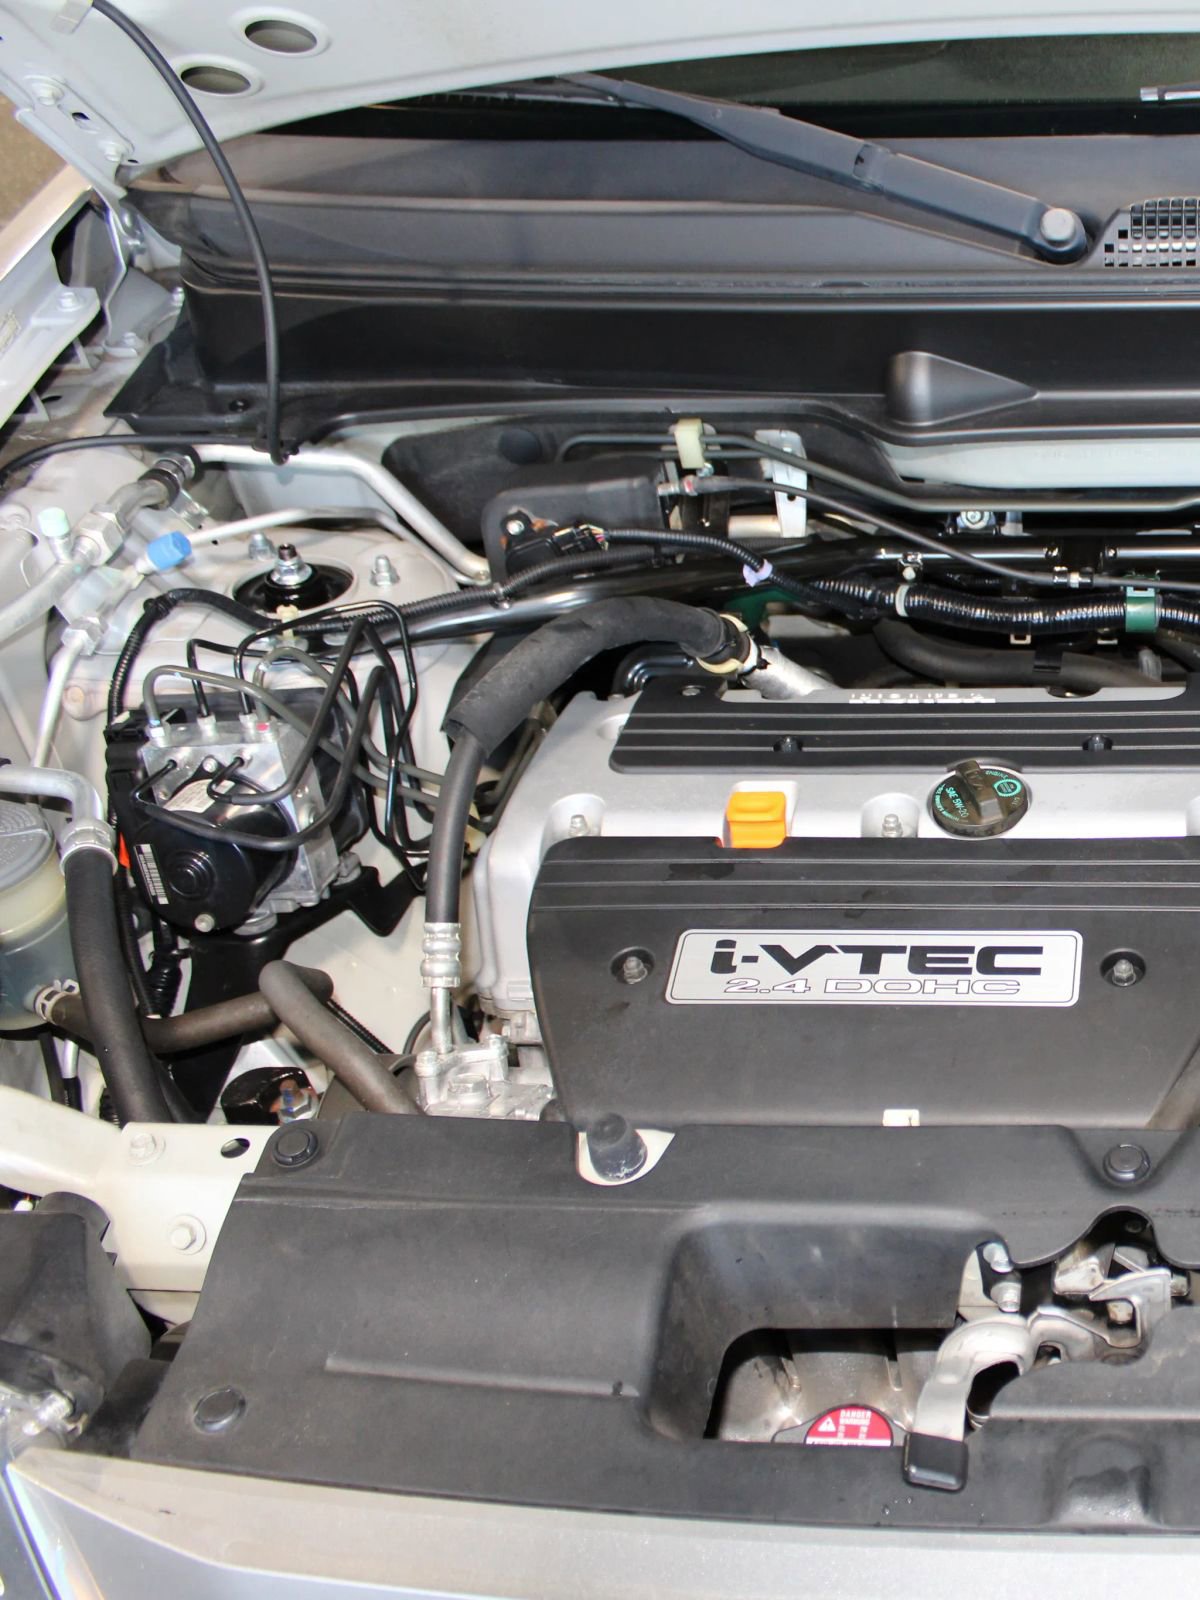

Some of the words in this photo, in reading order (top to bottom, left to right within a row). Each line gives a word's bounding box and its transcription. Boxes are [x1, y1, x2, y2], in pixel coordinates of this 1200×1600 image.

[710, 939, 1044, 976] i-VTEC
[724, 978, 811, 995] 2.4
[824, 978, 1021, 995] DOHC
[839, 1409, 872, 1419] DANGER
